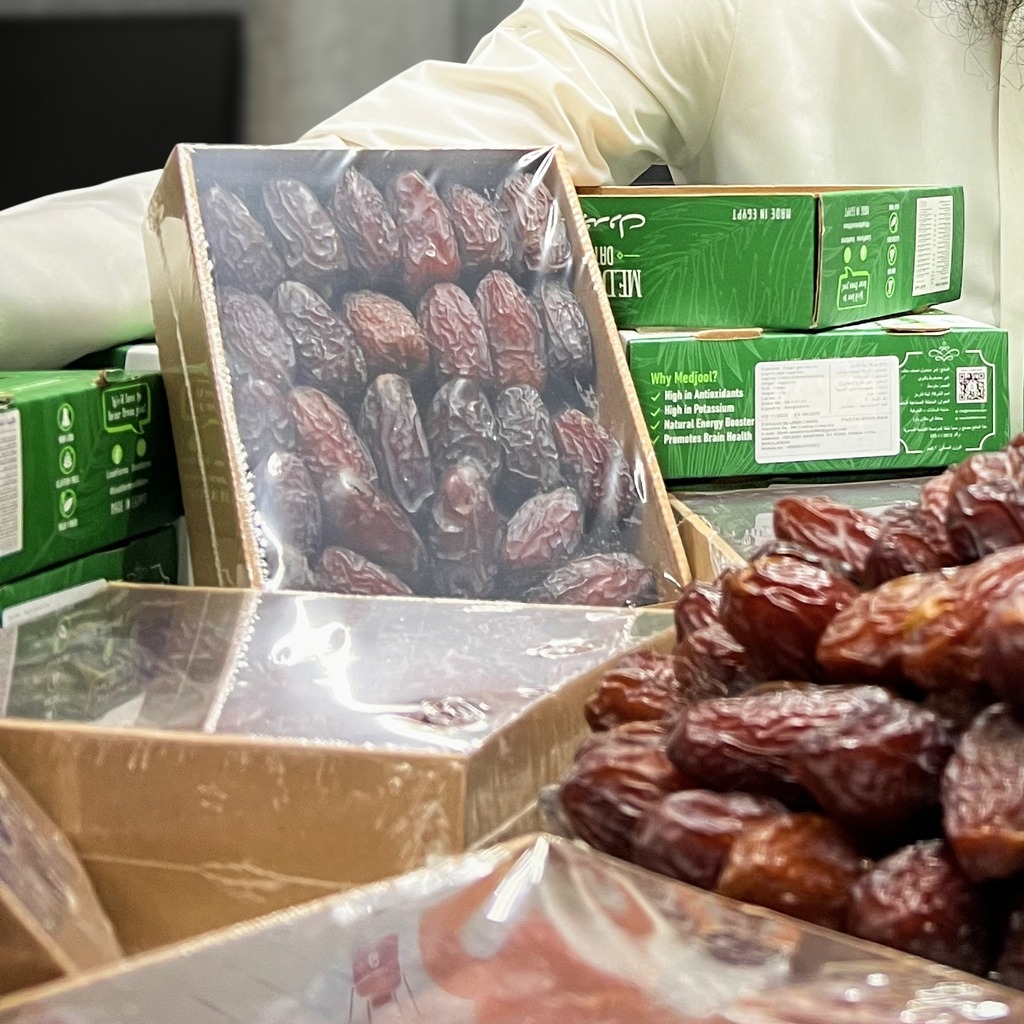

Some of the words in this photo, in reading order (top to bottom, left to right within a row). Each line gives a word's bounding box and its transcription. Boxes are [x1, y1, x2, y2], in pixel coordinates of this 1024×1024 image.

[732, 208, 758, 220] EGYPT
[760, 208, 768, 220] IN
[771, 208, 792, 219] MADE
[651, 372, 672, 387] Why
[674, 370, 718, 386] Medjool?
[665, 390, 682, 403] High
[684, 389, 692, 399] in
[694, 388, 743, 399] Antioxidants
[664, 405, 682, 417] High
[684, 404, 692, 414] in
[694, 403, 734, 414] Potassium
[664, 419, 694, 430] Natural
[696, 418, 724, 429] Energy
[725, 417, 755, 427] Booster
[664, 433, 701, 444] Promotes
[703, 432, 725, 442] Brain
[726, 431, 752, 441] Health
